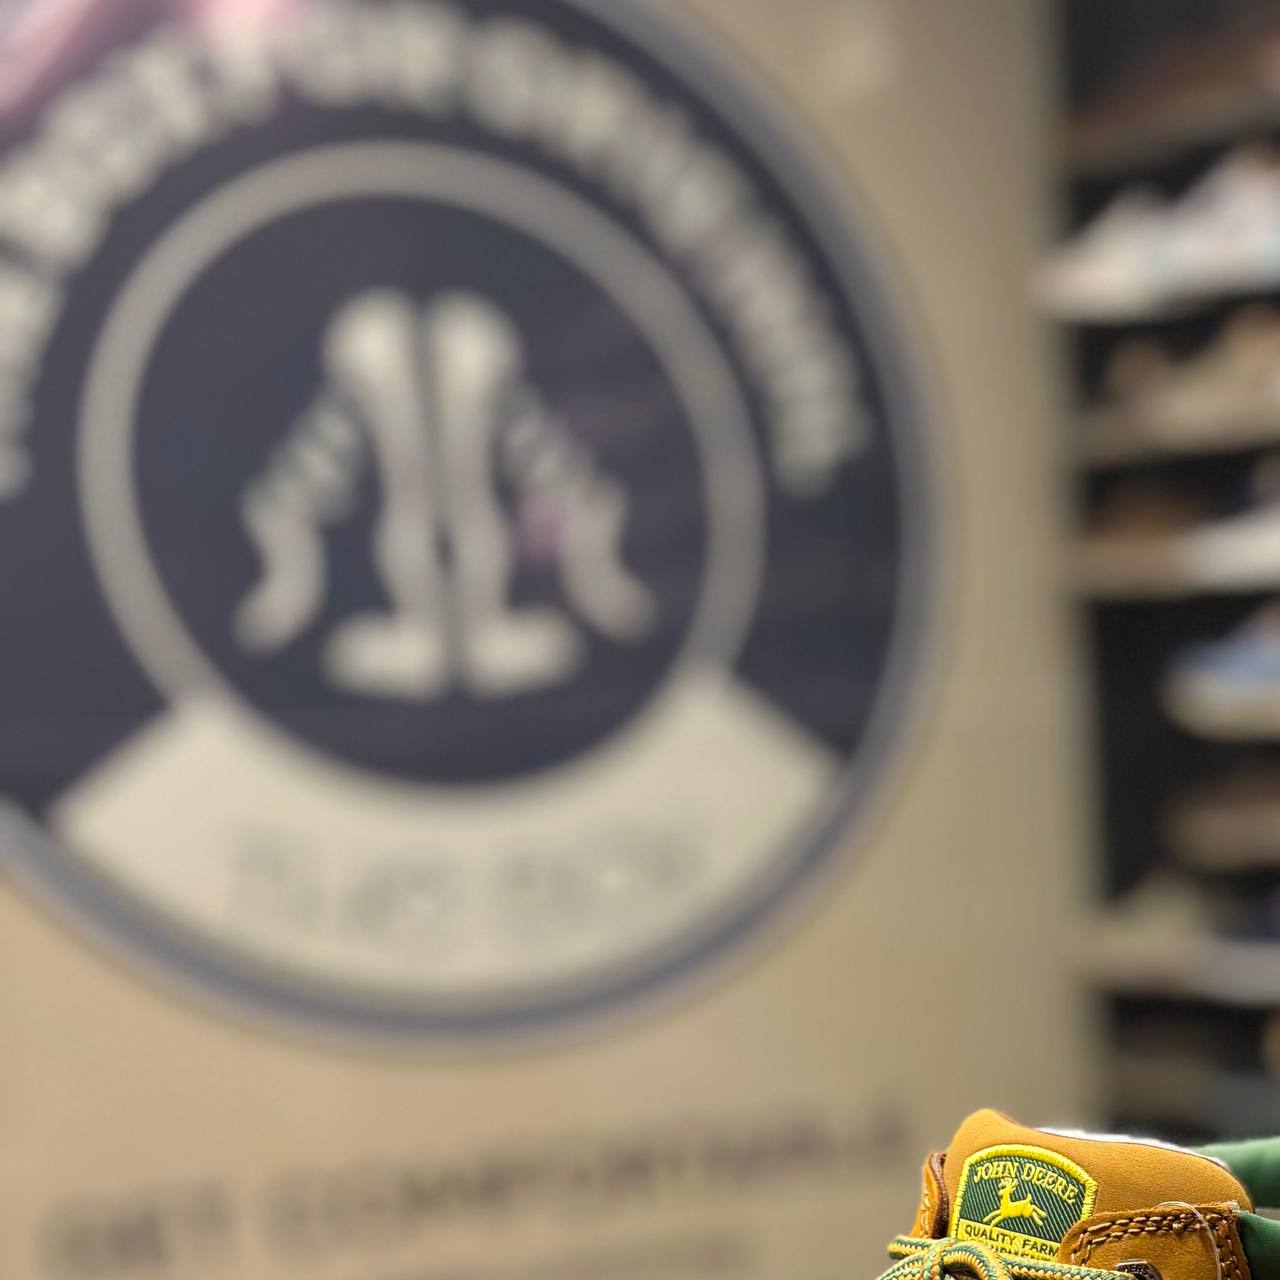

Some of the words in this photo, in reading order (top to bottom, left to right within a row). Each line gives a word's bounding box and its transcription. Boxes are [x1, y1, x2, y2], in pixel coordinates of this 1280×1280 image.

[974, 1161, 1020, 1184] JOHN
[1021, 1163, 1079, 1205] DEERE
[965, 1224, 1016, 1246] QUALITY
